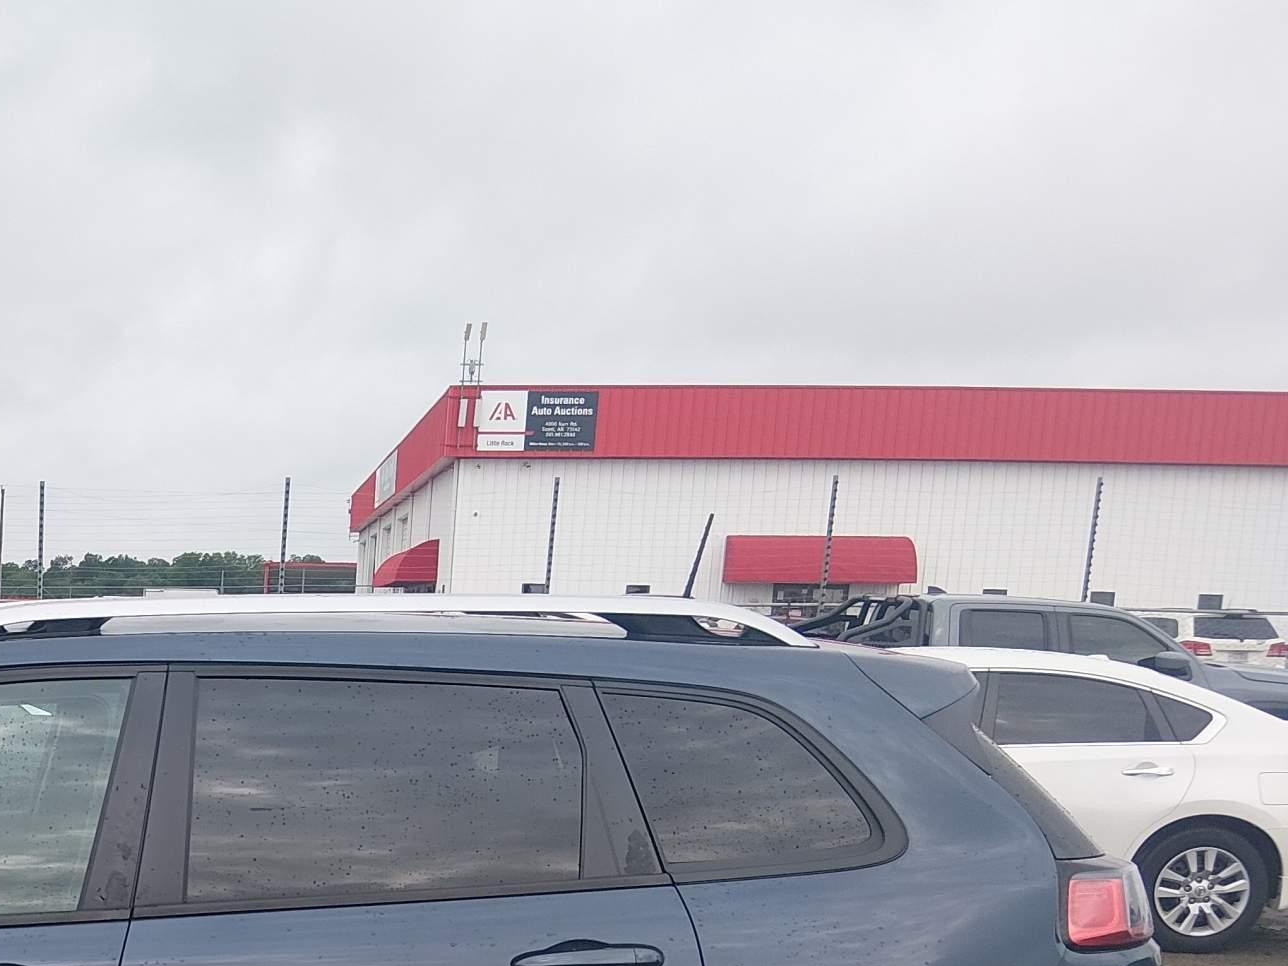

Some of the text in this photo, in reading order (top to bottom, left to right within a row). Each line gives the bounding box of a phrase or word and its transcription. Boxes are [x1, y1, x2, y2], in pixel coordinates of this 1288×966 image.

[541, 395, 585, 405] Insurance
[531, 406, 593, 416] Auto Auctions
